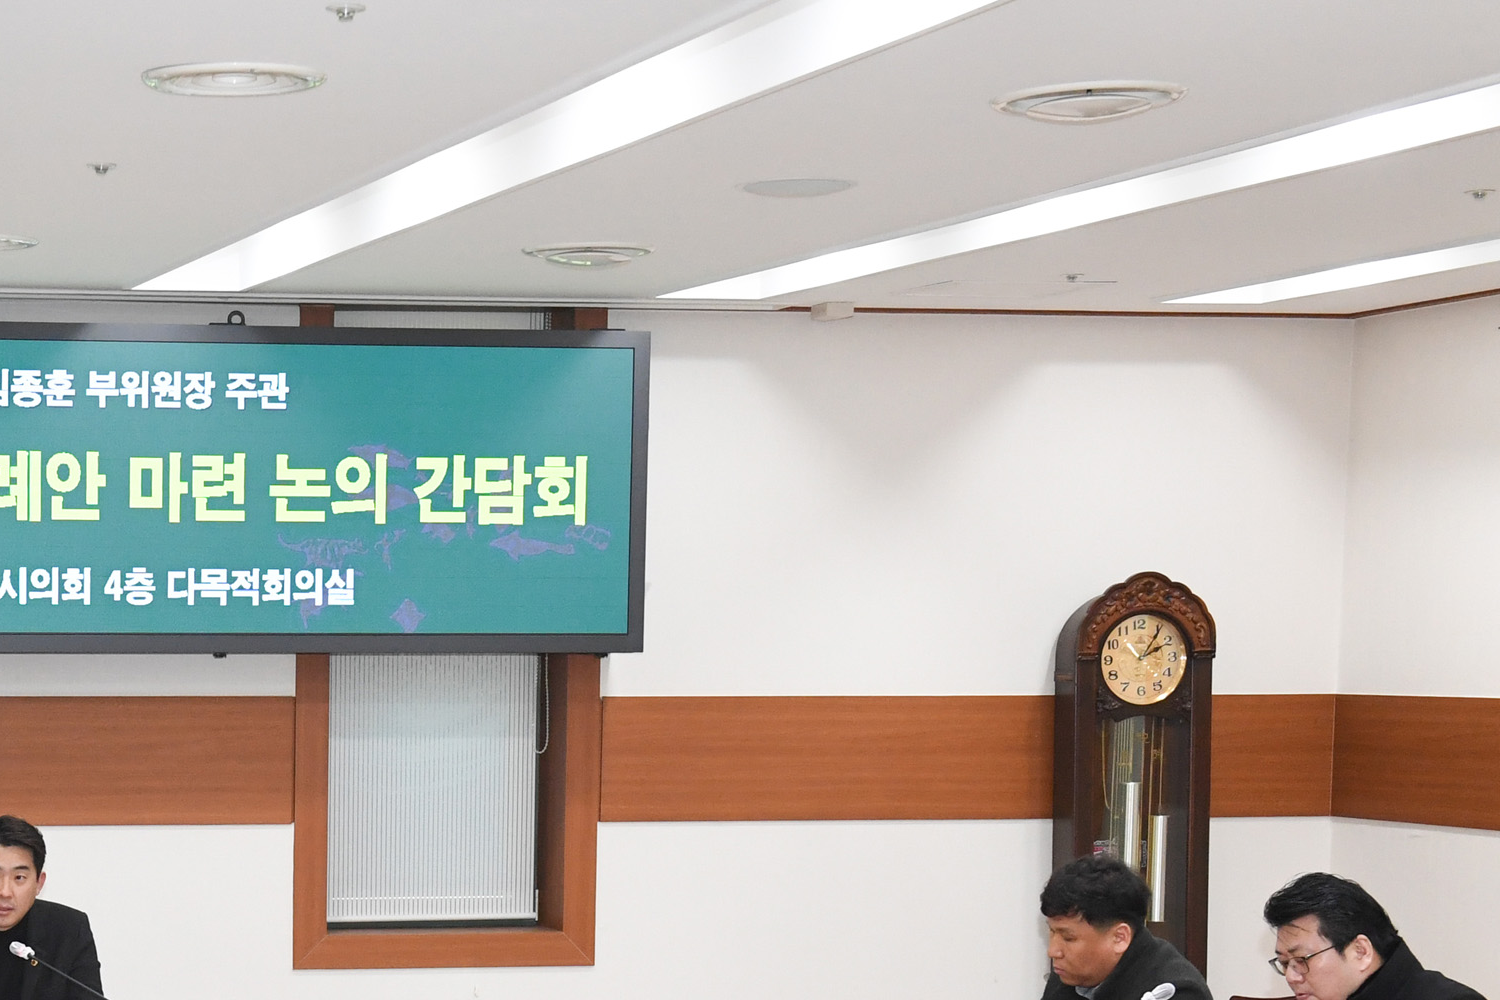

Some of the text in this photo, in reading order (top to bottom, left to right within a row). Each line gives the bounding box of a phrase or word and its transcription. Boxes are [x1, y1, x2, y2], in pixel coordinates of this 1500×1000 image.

[86, 370, 218, 412] 부위원장
[225, 372, 291, 412] 주관
[129, 452, 248, 525] 마련
[269, 453, 390, 527] 논의
[413, 454, 590, 528] 간담회
[104, 567, 157, 608] 4층
[167, 567, 357, 609] 다목적회의실
[1133, 619, 1146, 630] 12
[1118, 625, 1128, 636] 11
[1107, 639, 1119, 650] 10
[1104, 655, 1113, 665] 9
[1168, 651, 1177, 662] 3
[1108, 670, 1118, 680] 8
[1162, 667, 1172, 677] 4
[1120, 682, 1130, 692] 7
[1137, 686, 1146, 696] 6
[1152, 680, 1162, 691] 5
